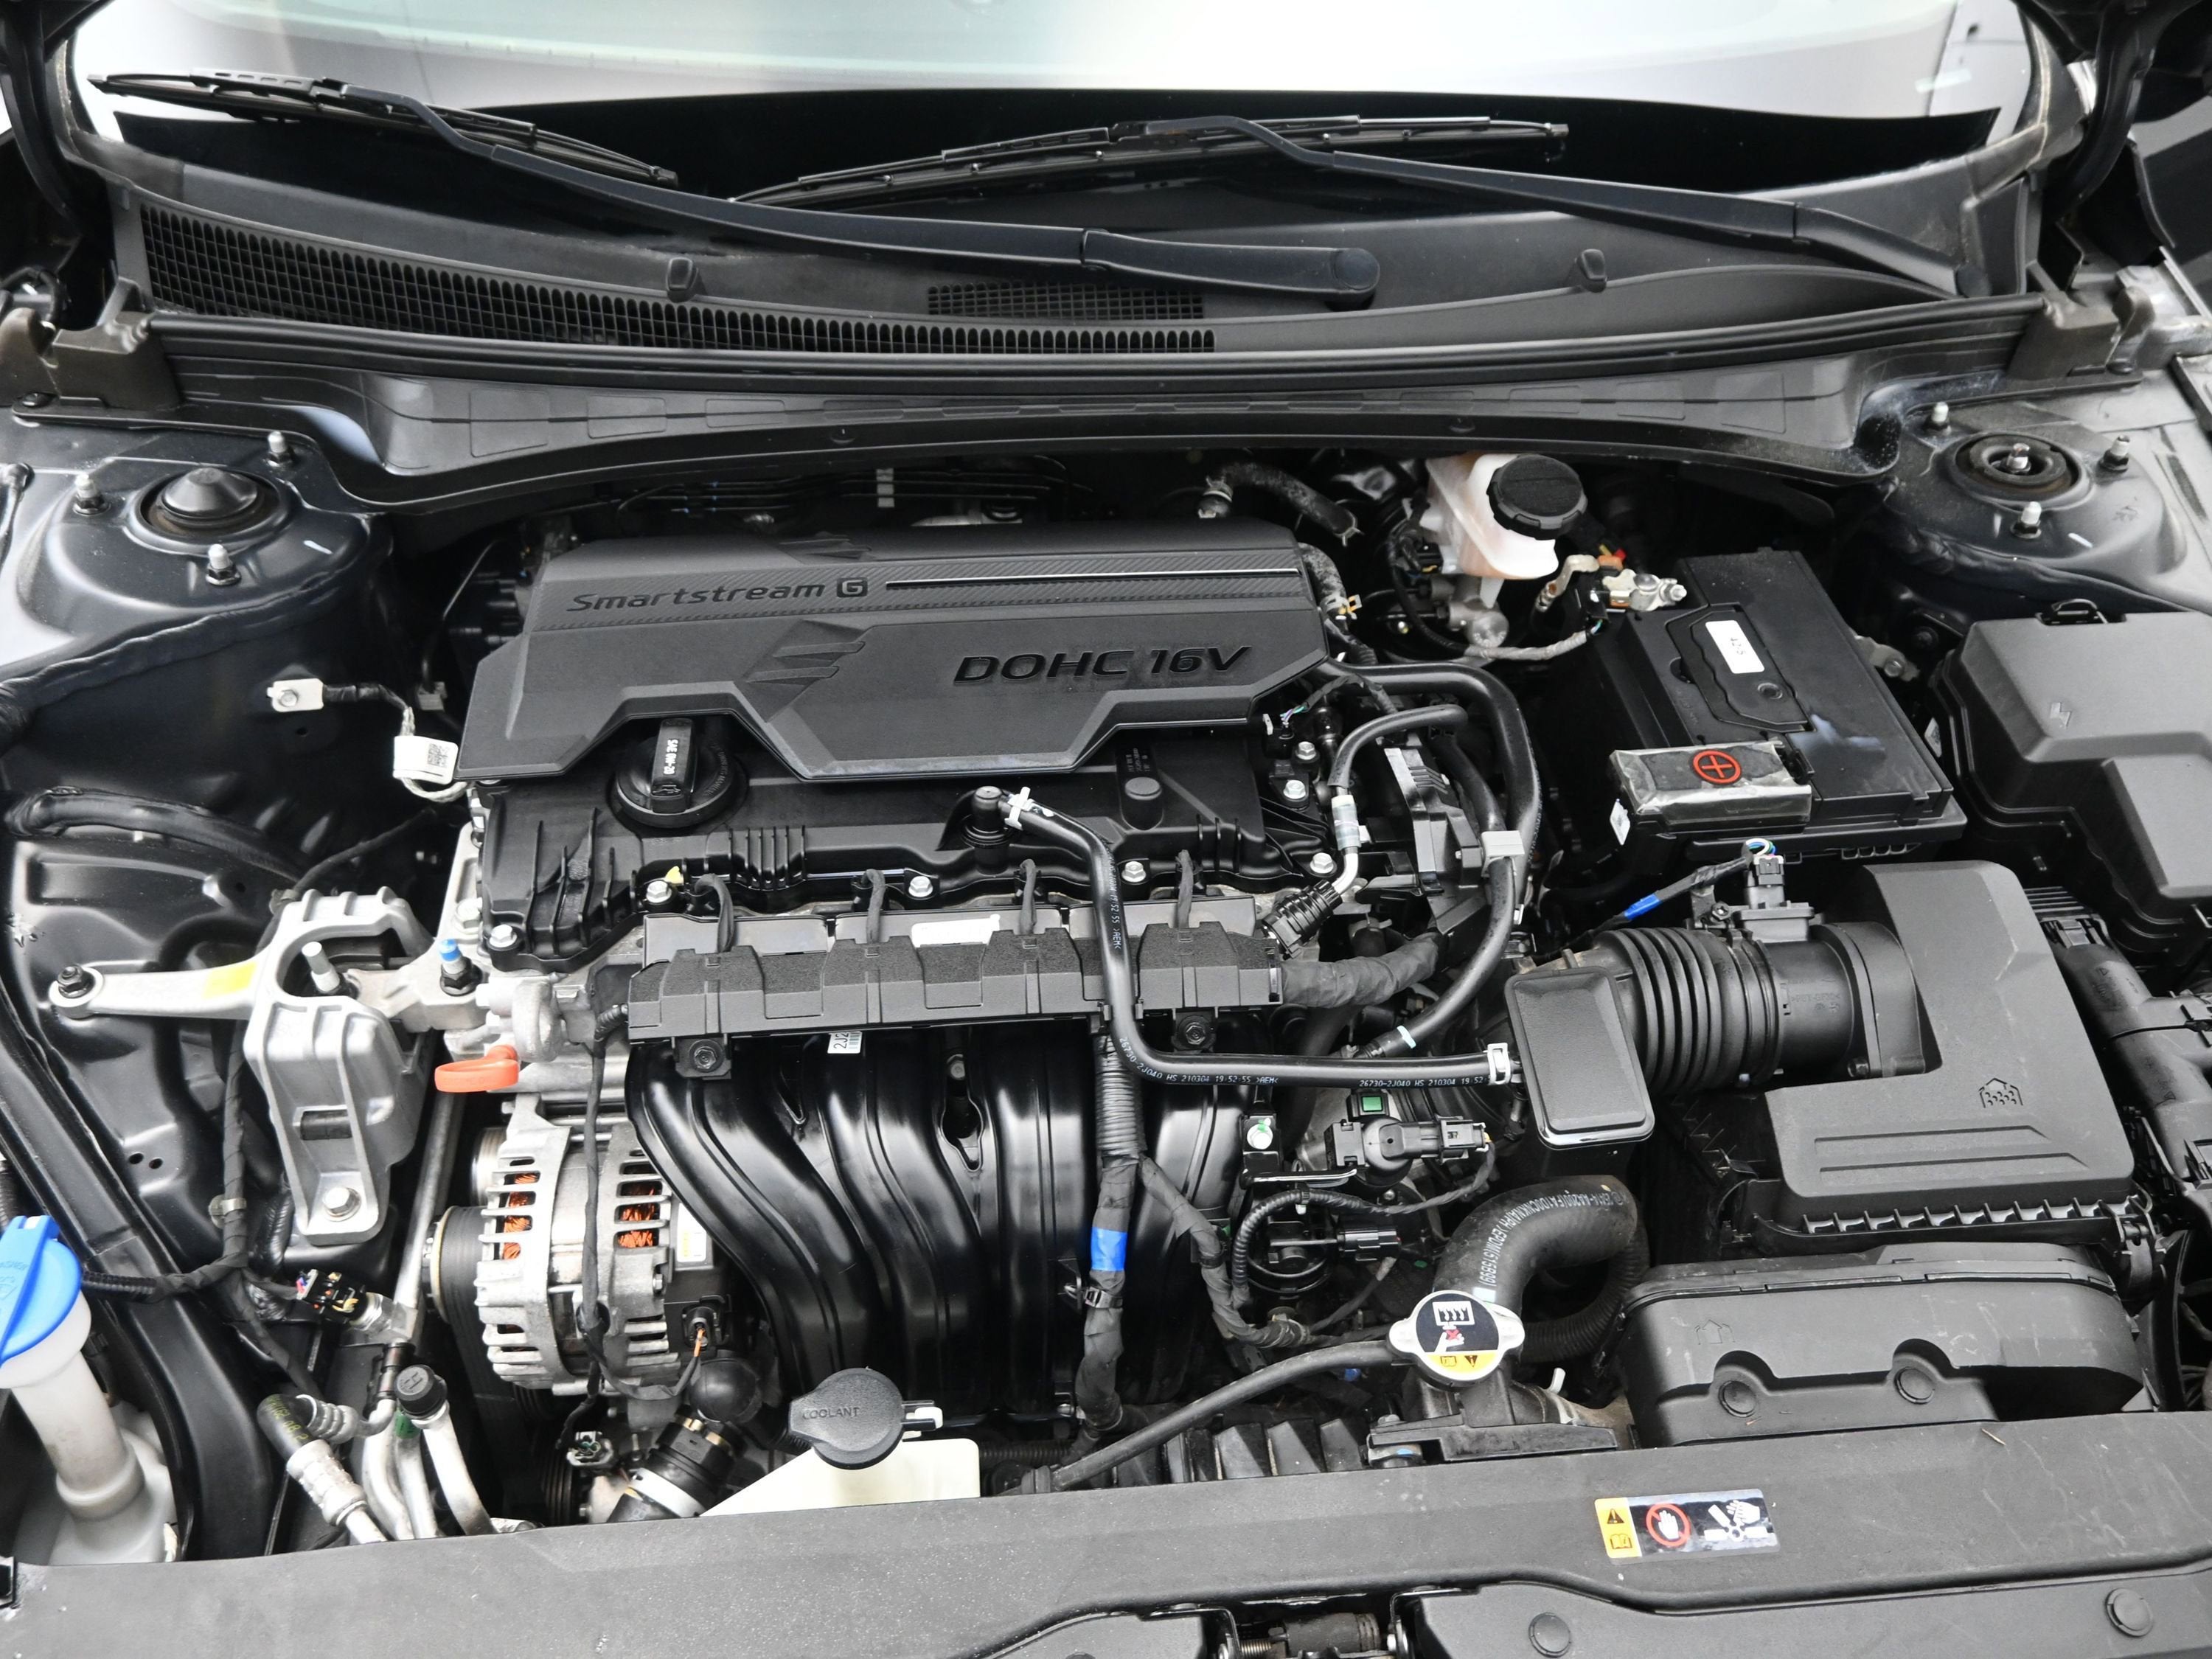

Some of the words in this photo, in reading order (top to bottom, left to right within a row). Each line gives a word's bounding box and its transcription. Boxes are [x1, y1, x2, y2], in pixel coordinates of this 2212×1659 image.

[566, 583, 826, 612] Smartstream
[838, 577, 867, 597] G
[953, 650, 1135, 683] DOHC
[1150, 645, 1253, 675] 16V
[666, 739, 679, 753] SAE
[1119, 1037, 1163, 1079] 26730-2J040
[1166, 1074, 1178, 1082] HS
[802, 1406, 860, 1420] COOLANT
